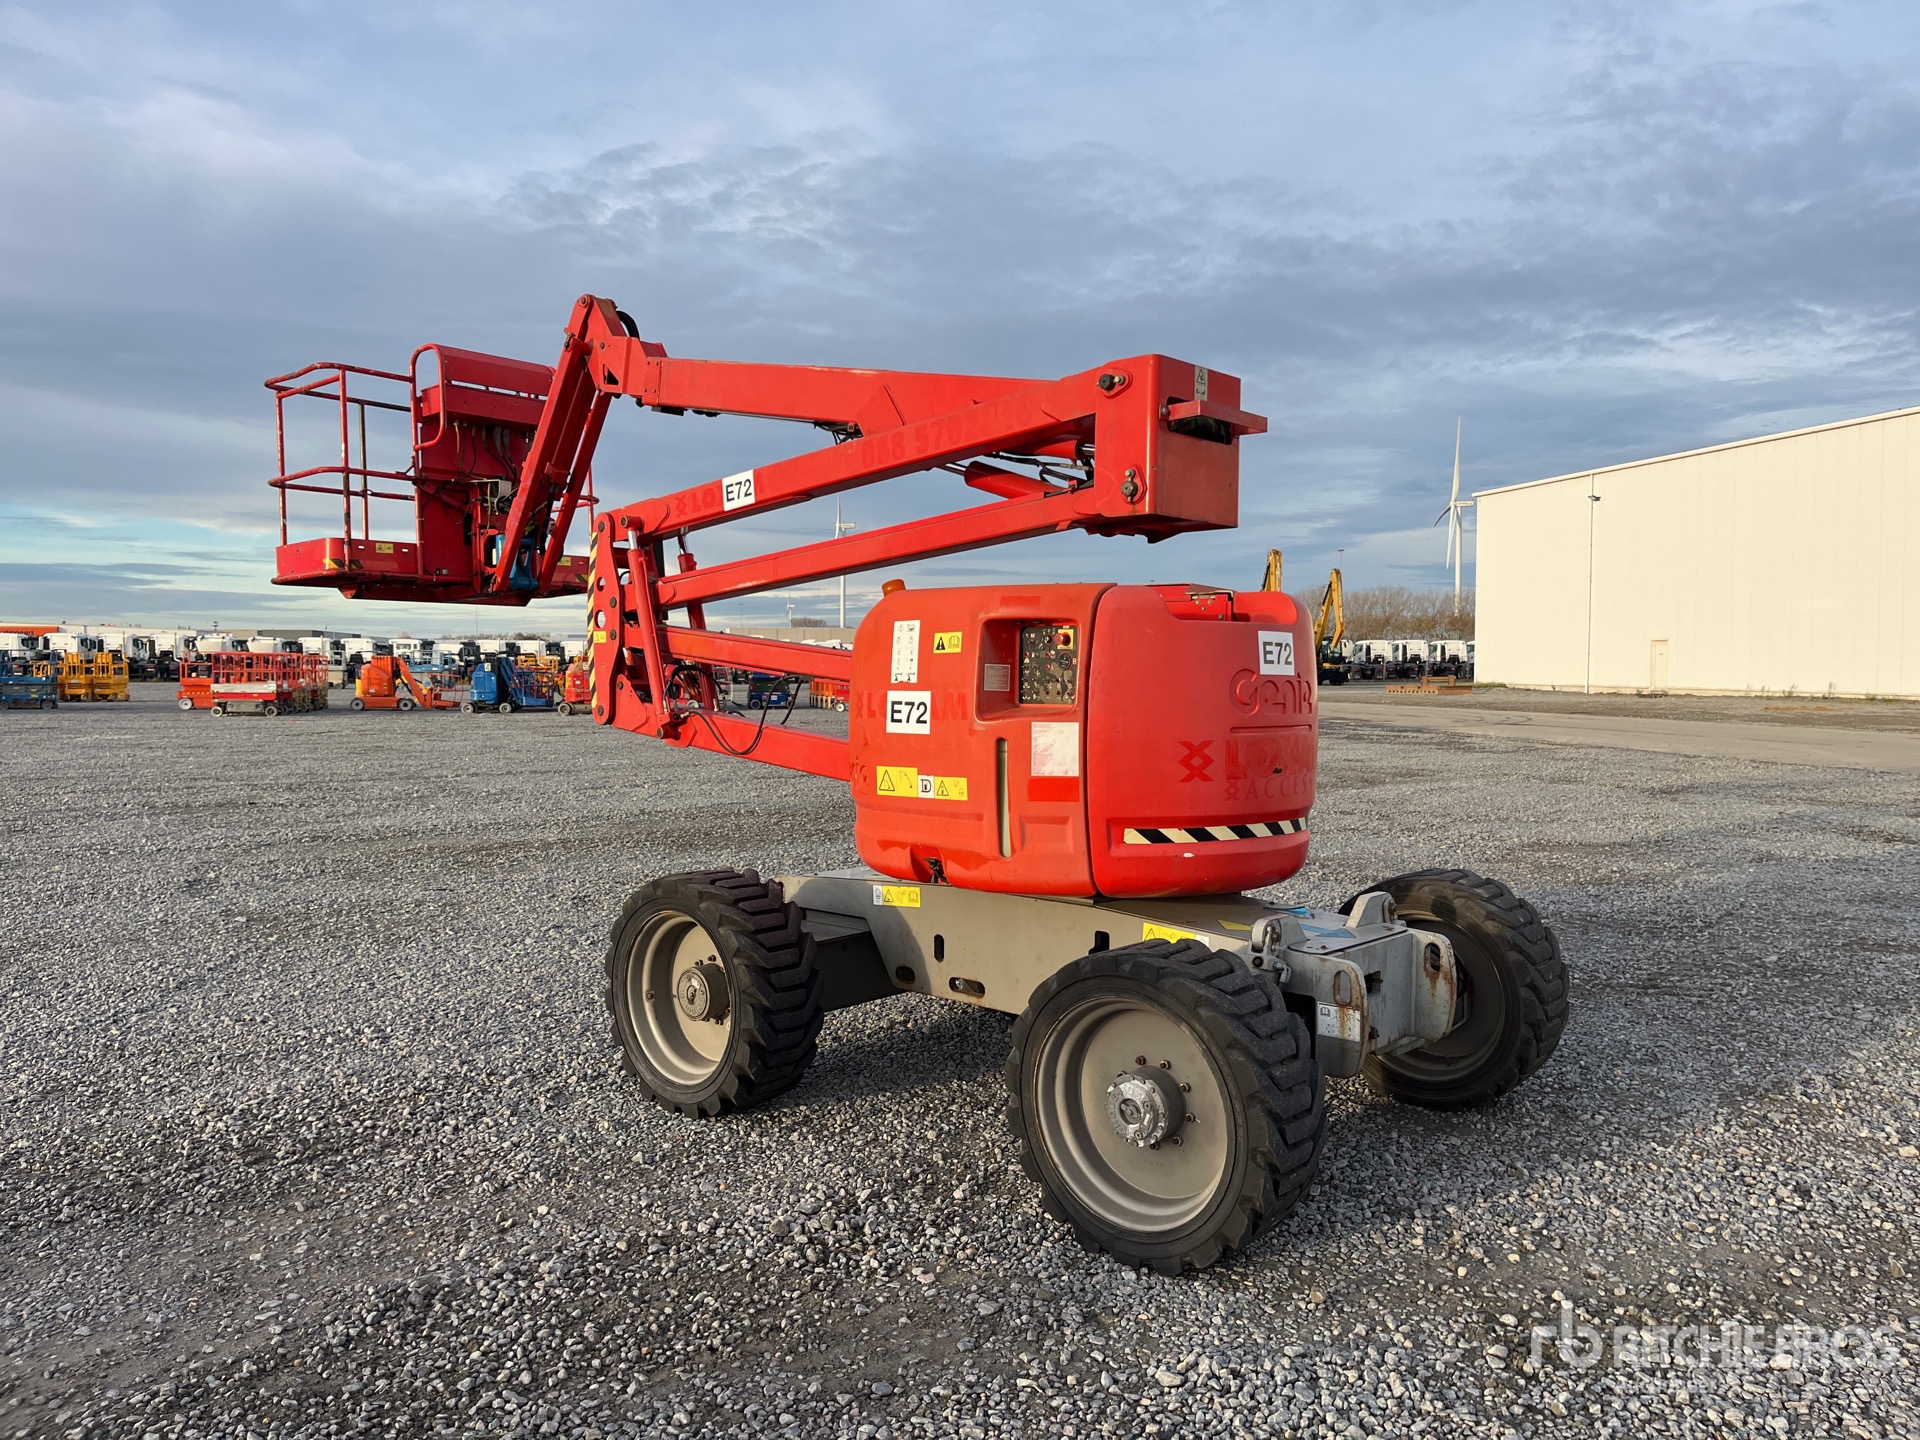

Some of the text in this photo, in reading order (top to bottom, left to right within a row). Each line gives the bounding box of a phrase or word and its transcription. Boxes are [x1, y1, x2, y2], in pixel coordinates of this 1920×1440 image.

[725, 478, 753, 503] E72
[1262, 641, 1293, 666] E72
[890, 700, 928, 724] E72
